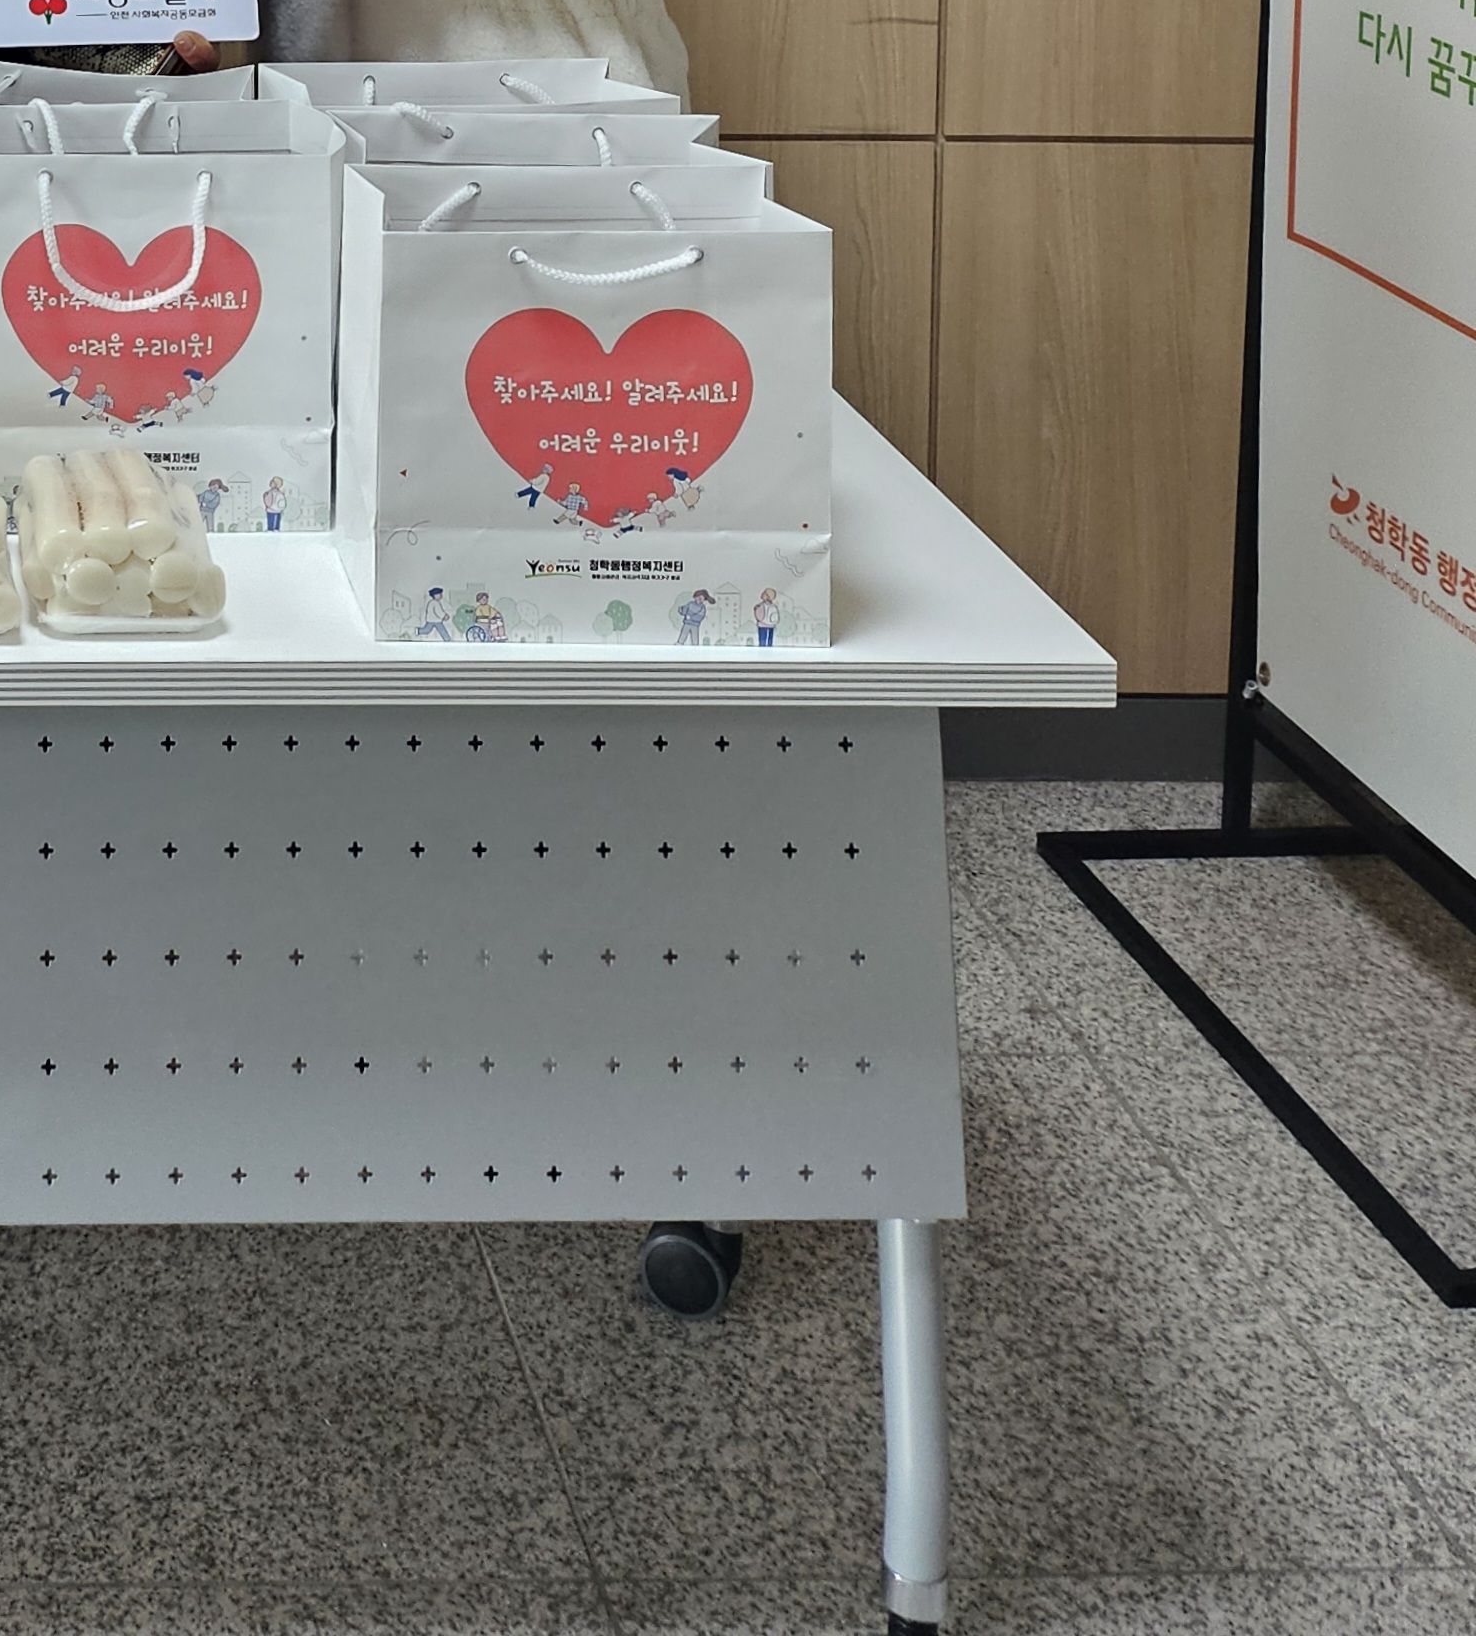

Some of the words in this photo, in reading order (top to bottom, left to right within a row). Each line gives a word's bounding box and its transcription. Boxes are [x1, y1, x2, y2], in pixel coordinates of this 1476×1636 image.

[1359, 11, 1412, 77] 다시
[69, 333, 124, 357] 어려운
[133, 334, 212, 358] 우리이웃!
[494, 375, 612, 404] 찾아주세요!
[623, 379, 738, 405] 알려주세요!
[539, 428, 601, 454] 어려운
[610, 429, 698, 455] 우리이웃!
[1366, 501, 1431, 575] 청학동
[1329, 524, 1420, 604] Cheonghak-dong
